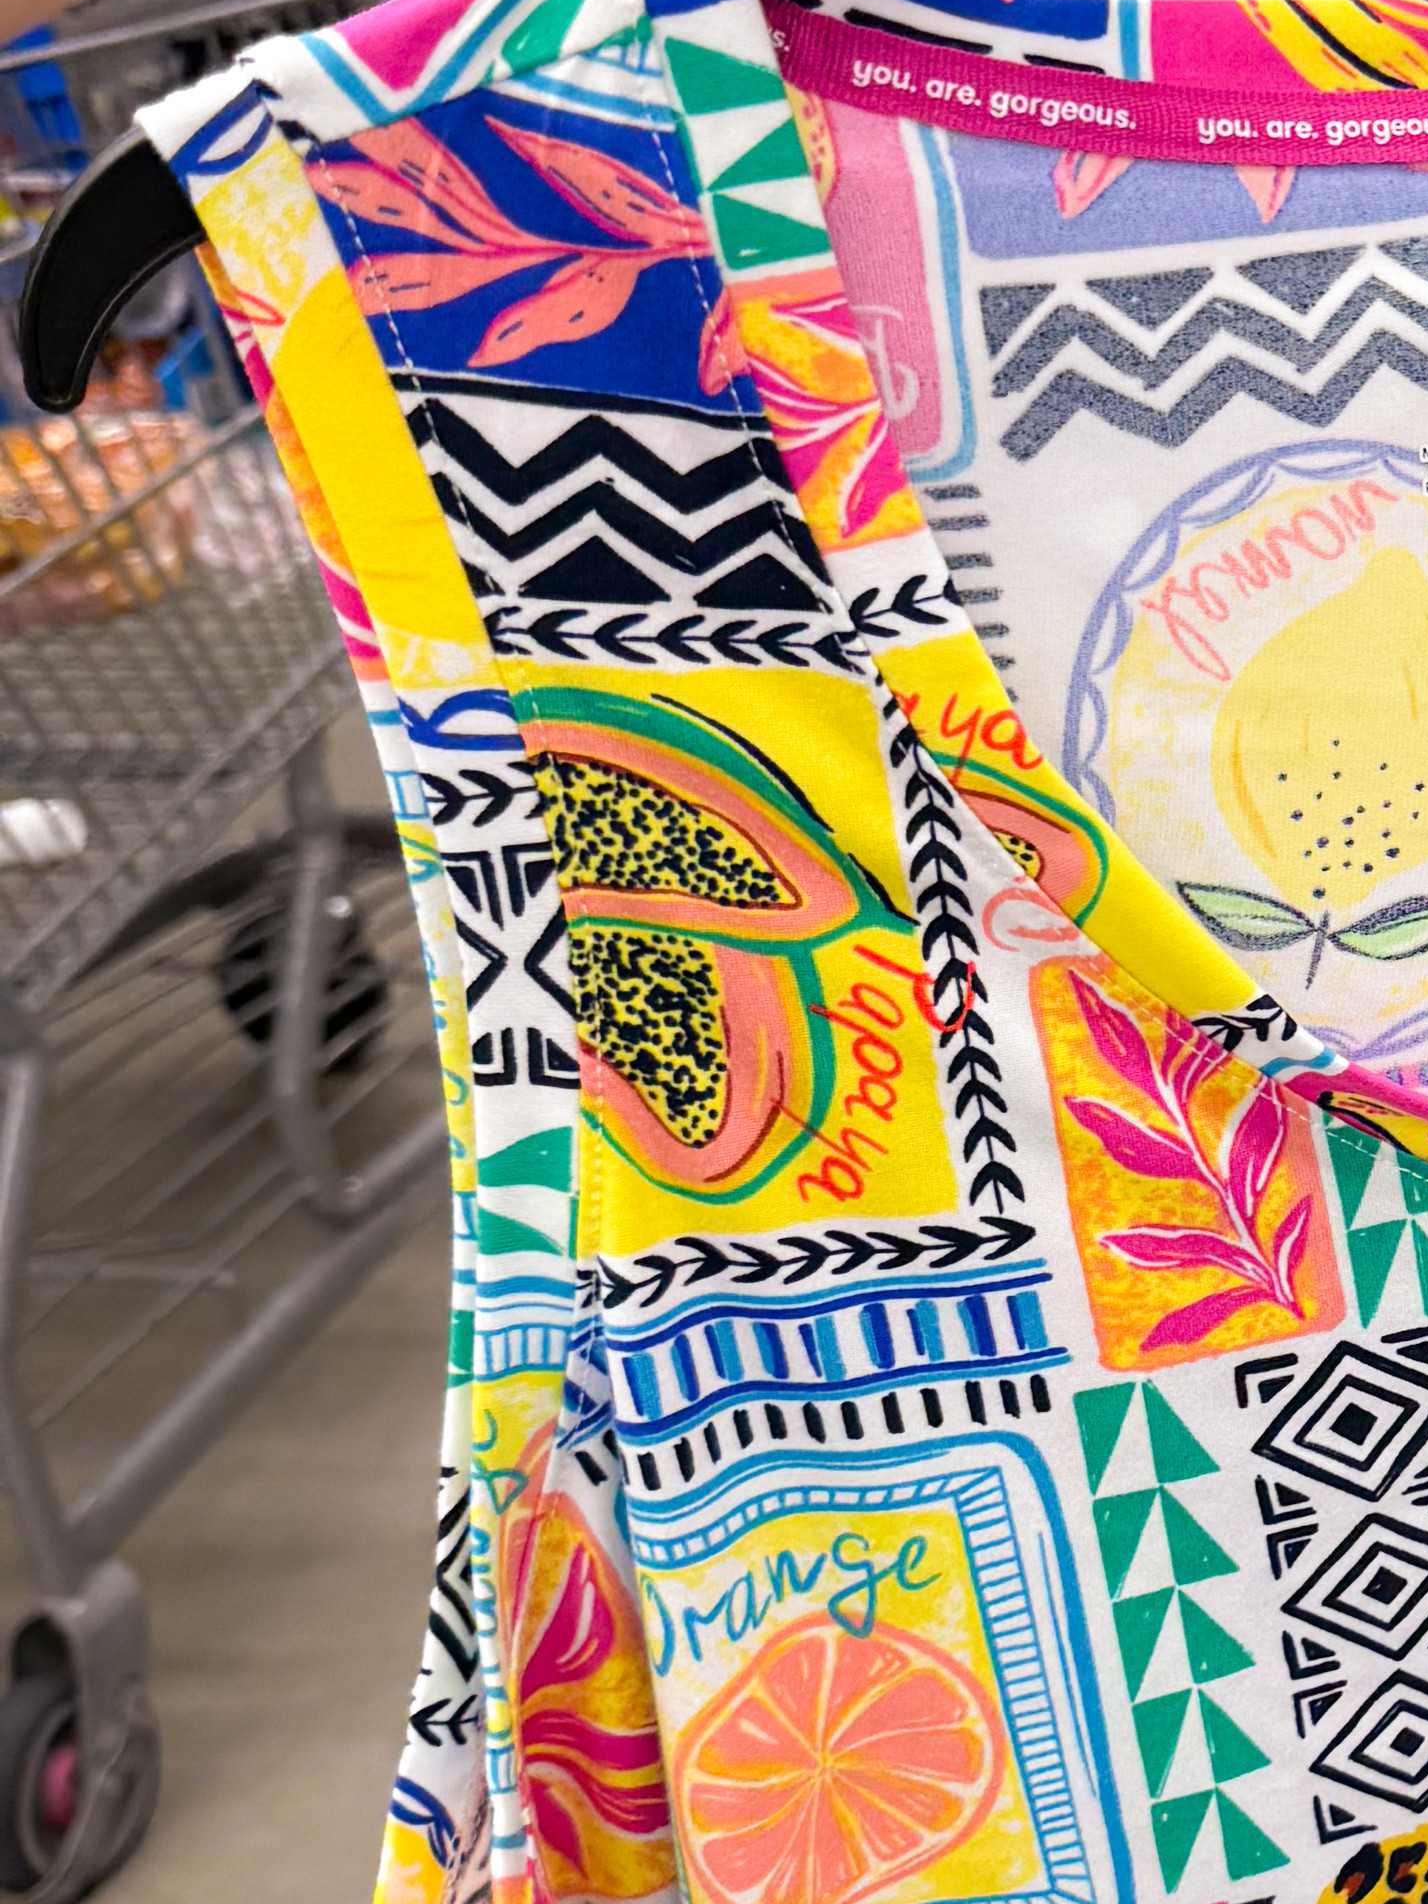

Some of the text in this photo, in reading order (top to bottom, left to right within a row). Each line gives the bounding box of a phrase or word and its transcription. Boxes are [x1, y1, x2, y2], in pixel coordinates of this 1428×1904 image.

[852, 60, 1137, 130] you. are. gorgeous.
[1199, 116, 1258, 144] you.
[1267, 119, 1319, 140] are.
